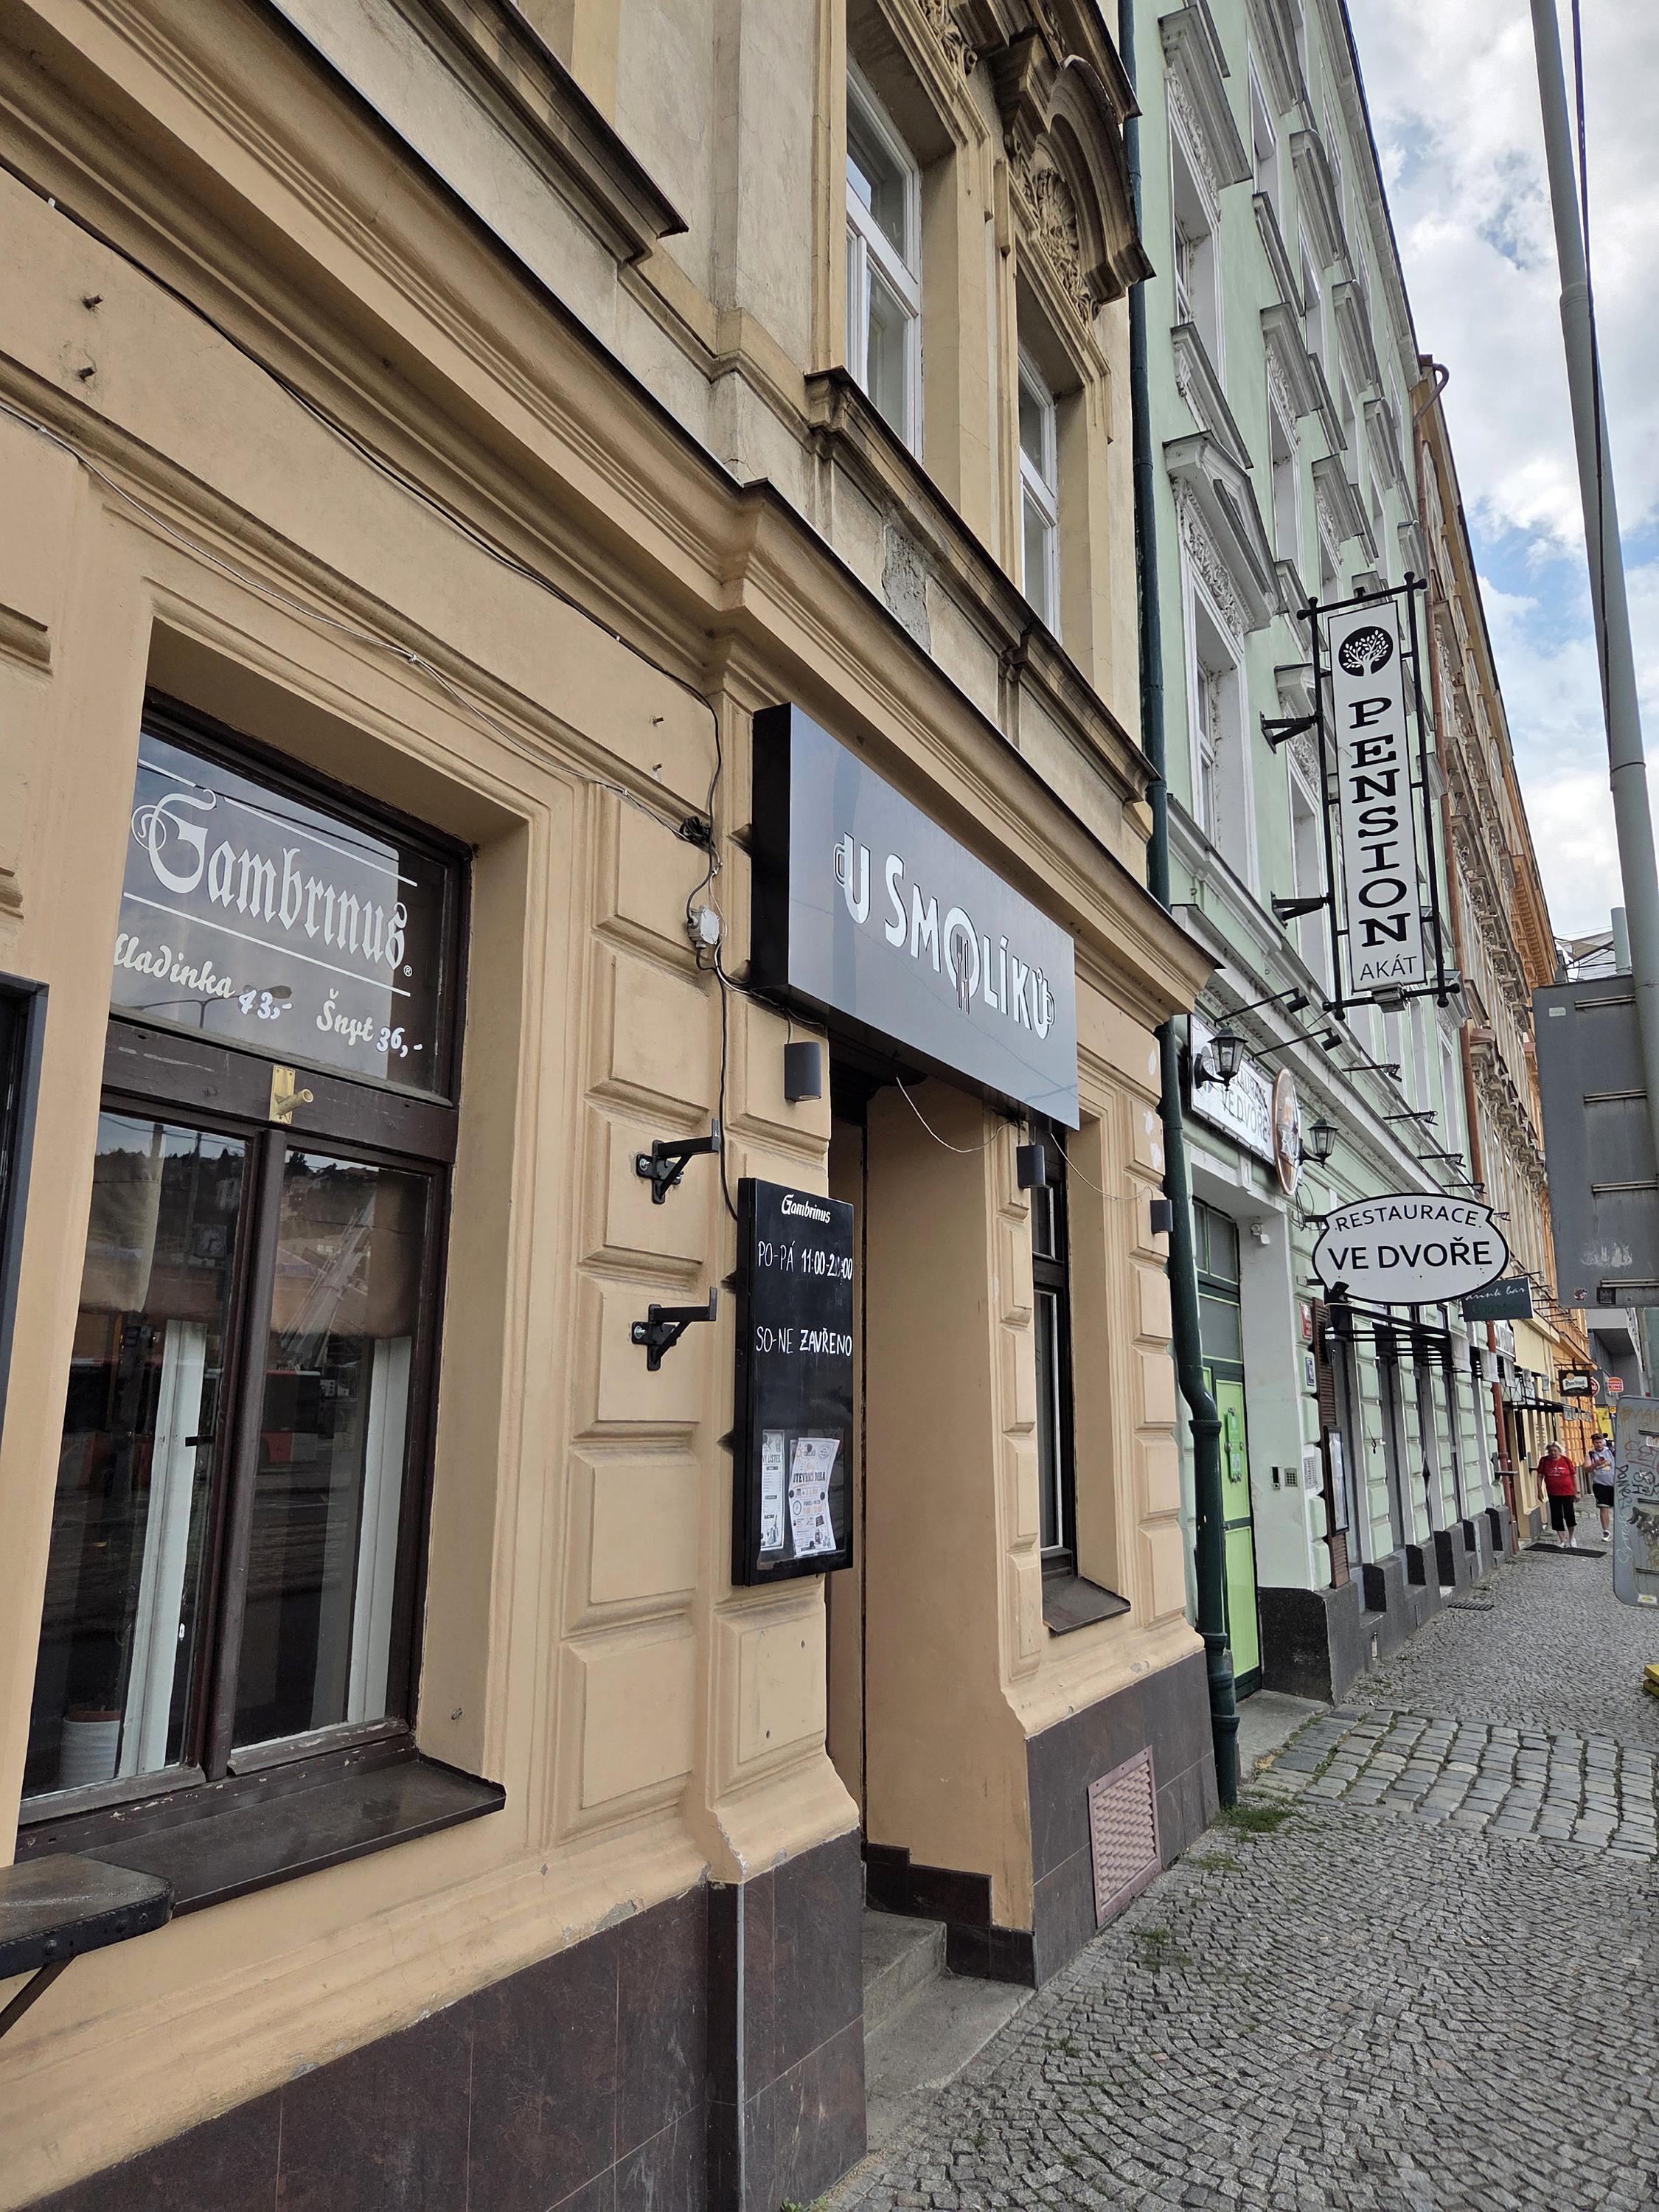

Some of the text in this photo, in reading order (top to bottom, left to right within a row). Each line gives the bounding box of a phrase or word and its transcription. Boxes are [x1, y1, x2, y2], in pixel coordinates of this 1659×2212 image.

[1349, 696, 1411, 948] PENSION
[833, 831, 1055, 1040] U SMOLÍKŮ
[1360, 953, 1417, 981] AKÁT
[316, 988, 375, 1046] Šnyt
[376, 1026, 423, 1058] 36,-
[782, 1194, 832, 1224] Gambrinus
[1335, 1204, 1479, 1232] RESTAURACE
[758, 1240, 796, 1273] PO-PÁ
[1327, 1237, 1493, 1270] VE DVOŘE
[756, 1326, 852, 1357] SO-NE ZAVŘENO
